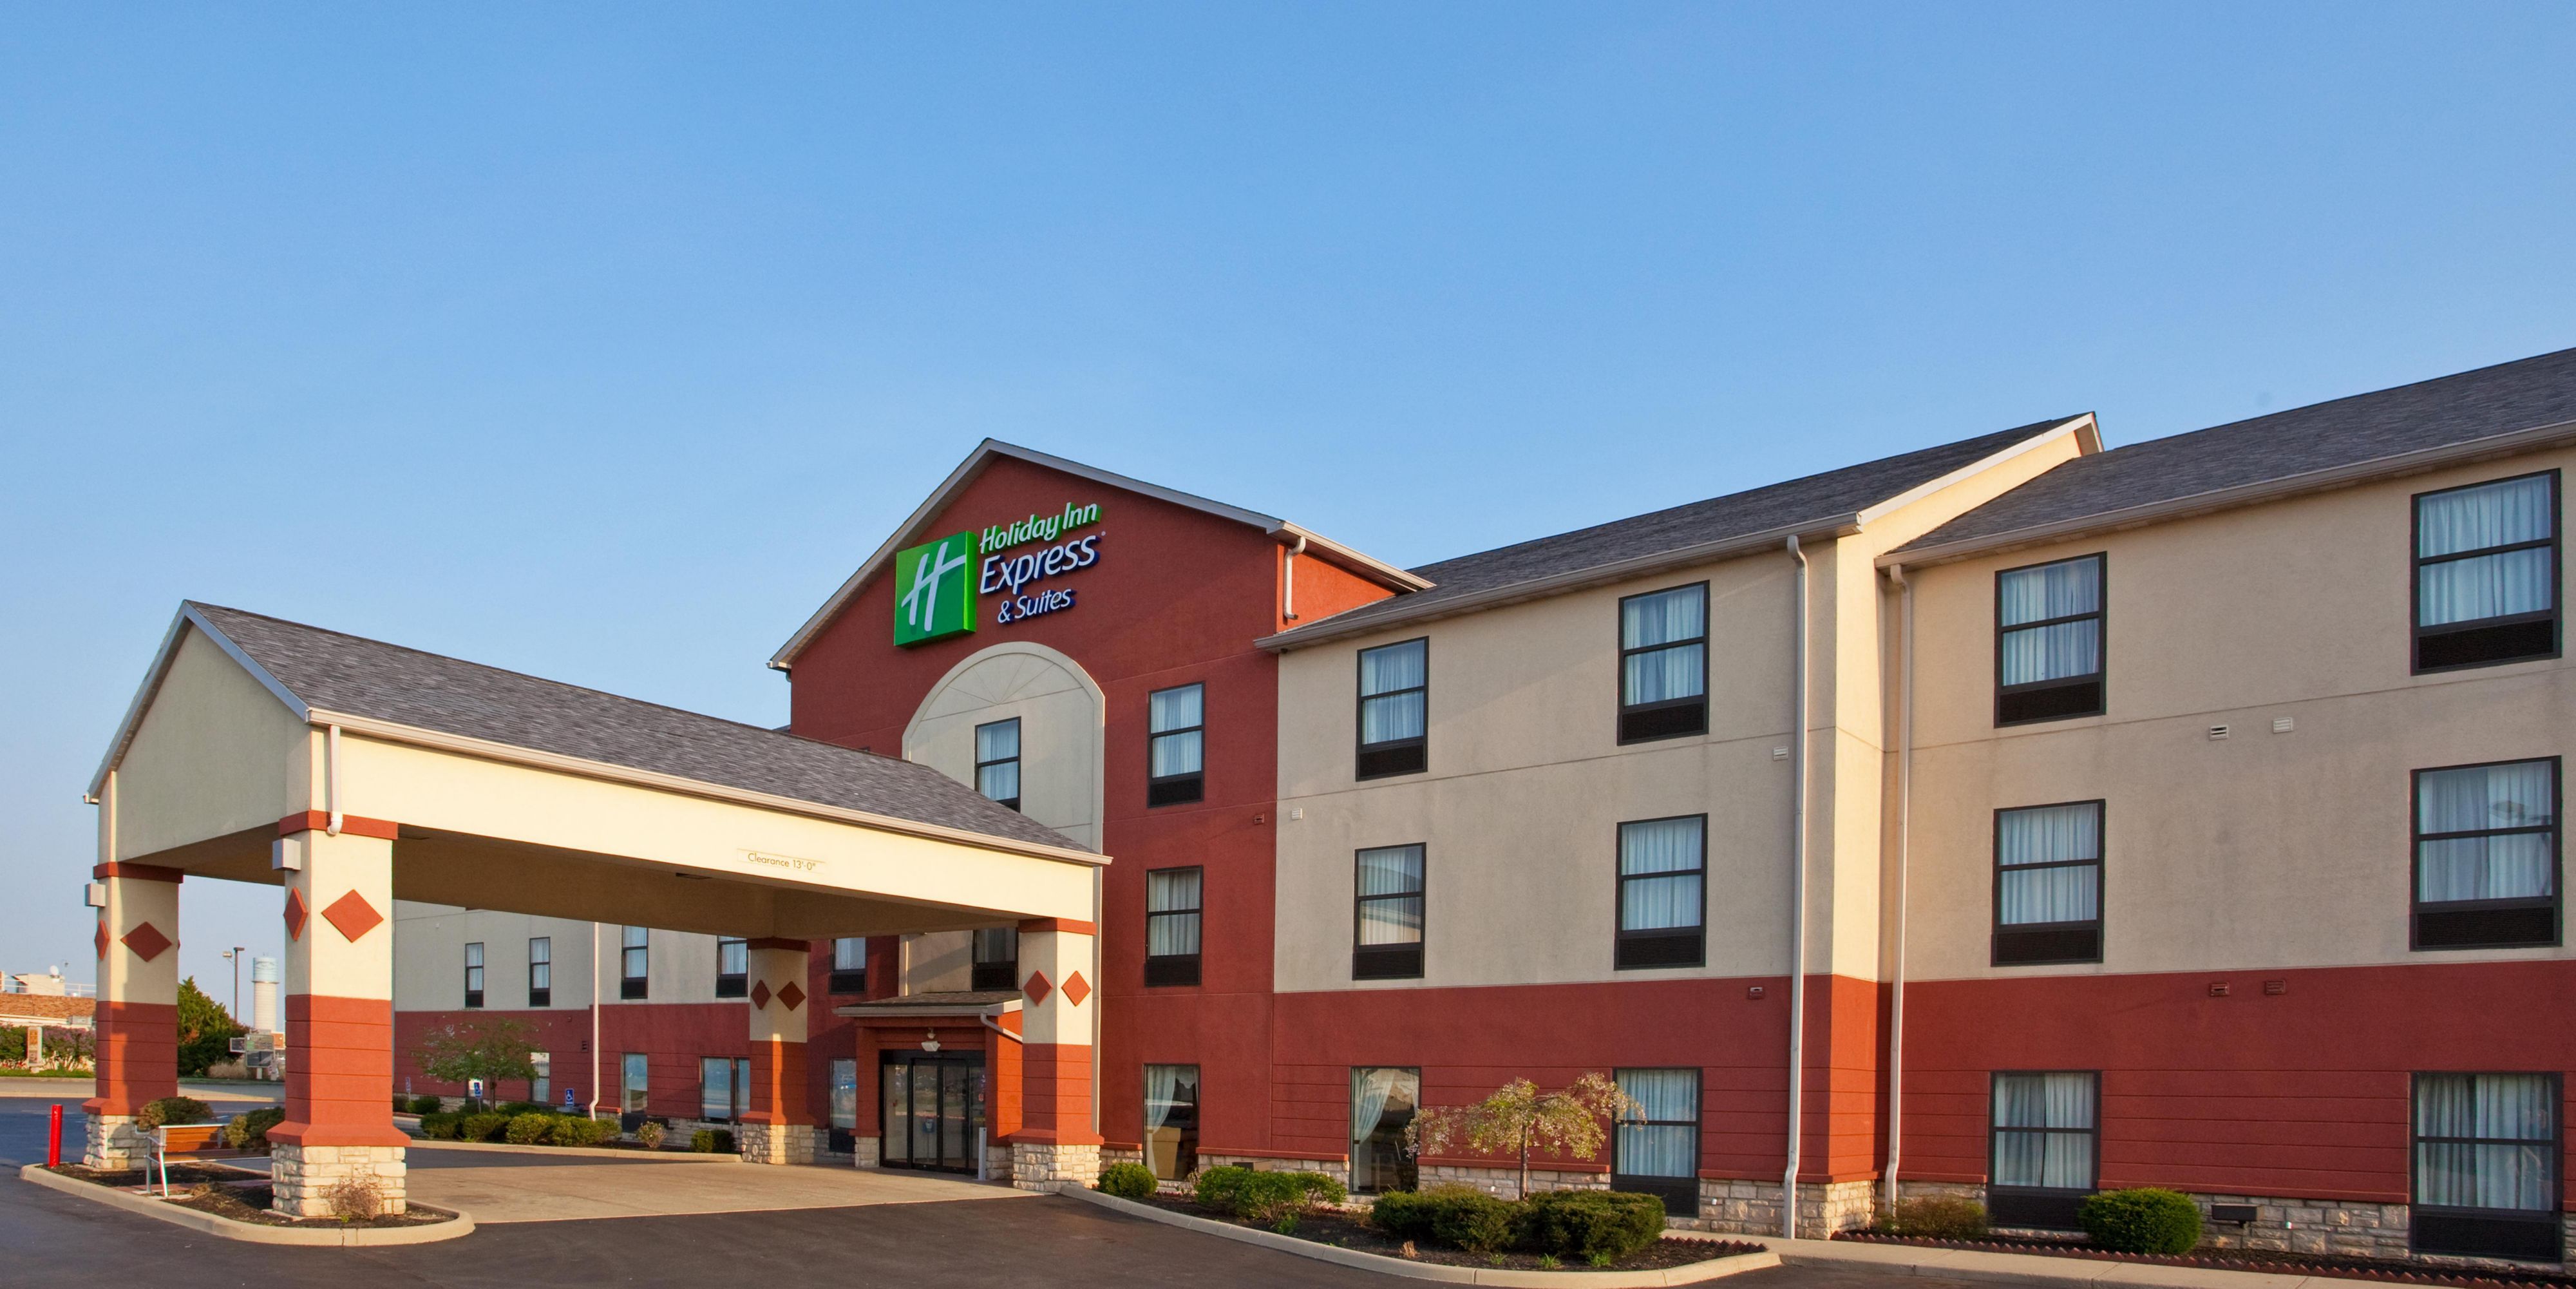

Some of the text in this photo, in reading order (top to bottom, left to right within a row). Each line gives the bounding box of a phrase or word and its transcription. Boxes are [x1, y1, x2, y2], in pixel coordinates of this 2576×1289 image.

[980, 502, 1099, 555] Holiday Inn
[980, 535, 1098, 595] Express
[998, 589, 1072, 624] & Suites
[748, 852, 790, 867] Clearance
